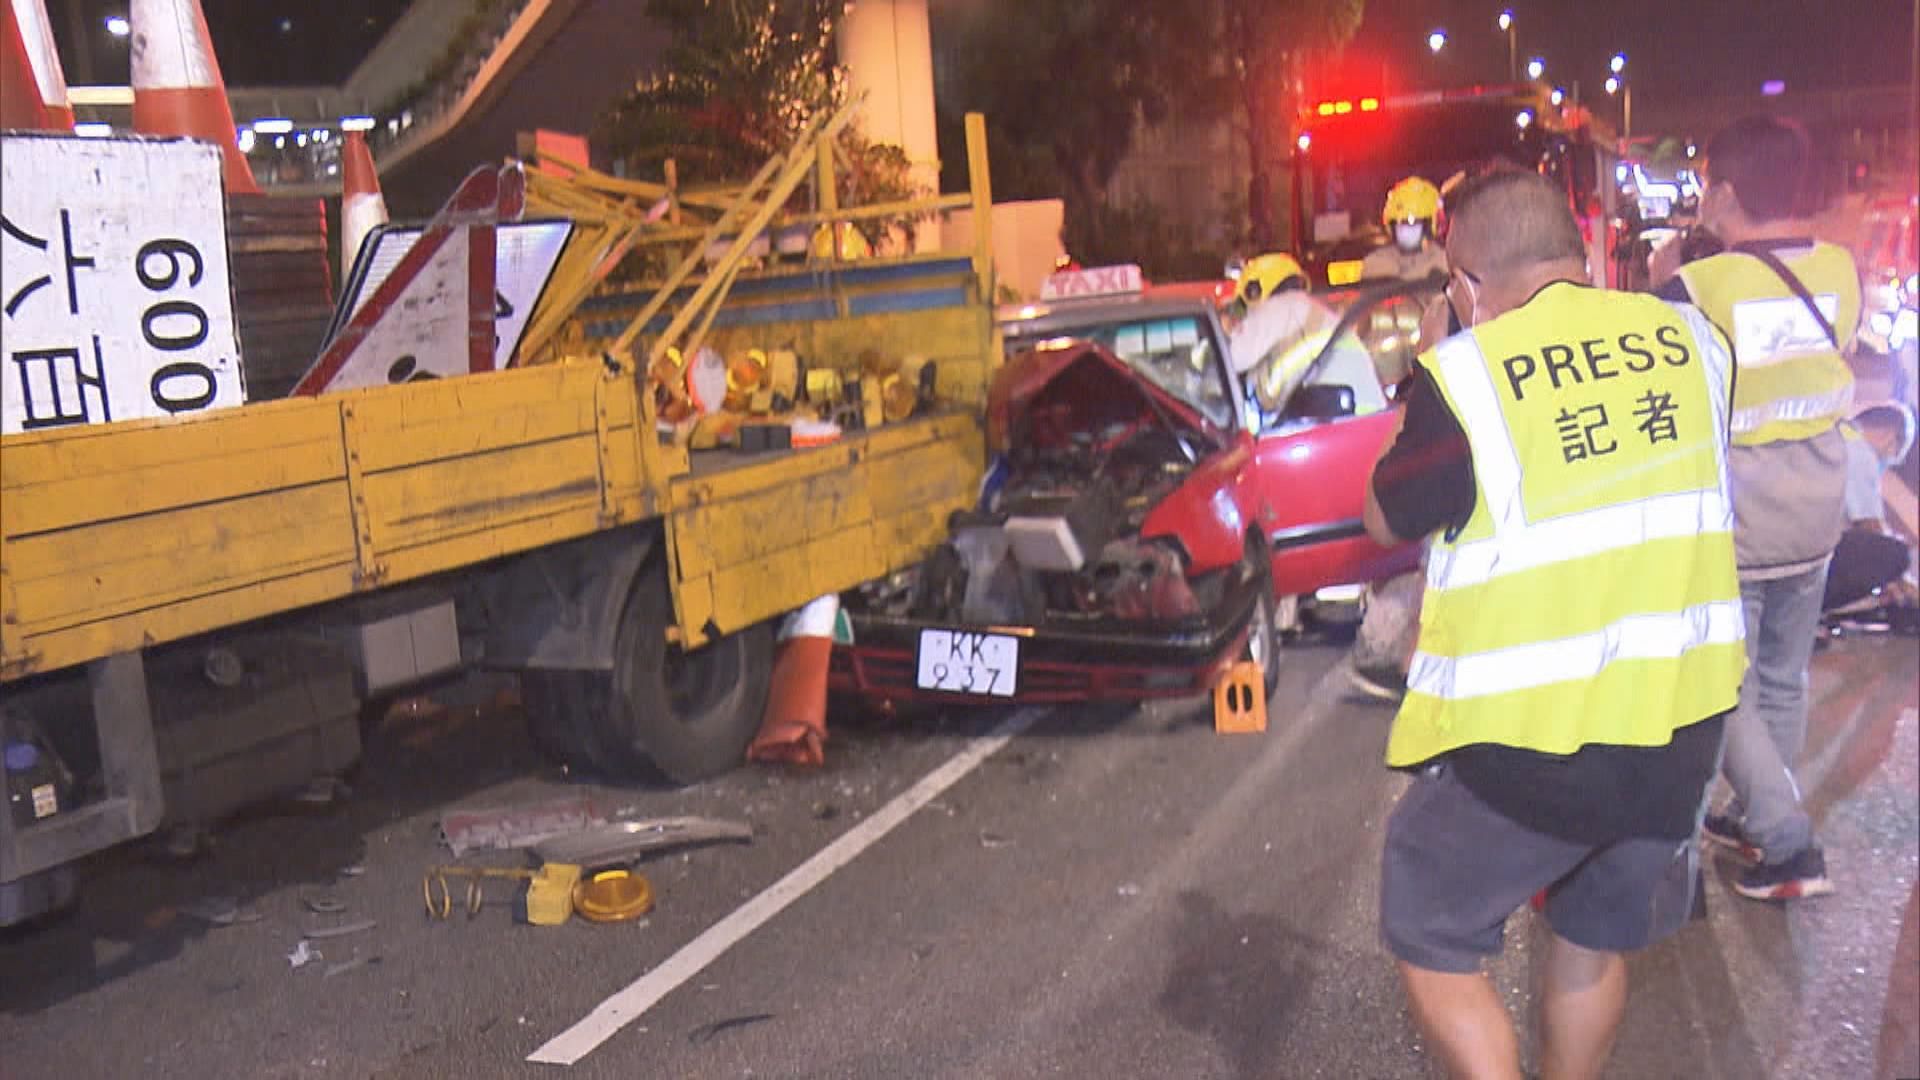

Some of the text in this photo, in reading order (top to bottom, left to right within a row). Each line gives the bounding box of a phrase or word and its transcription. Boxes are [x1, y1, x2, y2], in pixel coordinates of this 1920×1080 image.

[1050, 266, 1129, 296] TAXI
[135, 238, 217, 413] 600
[1503, 326, 1690, 401] PRESS
[1554, 389, 1679, 464] 記者
[950, 633, 987, 664] KK
[933, 663, 1001, 697] 937
